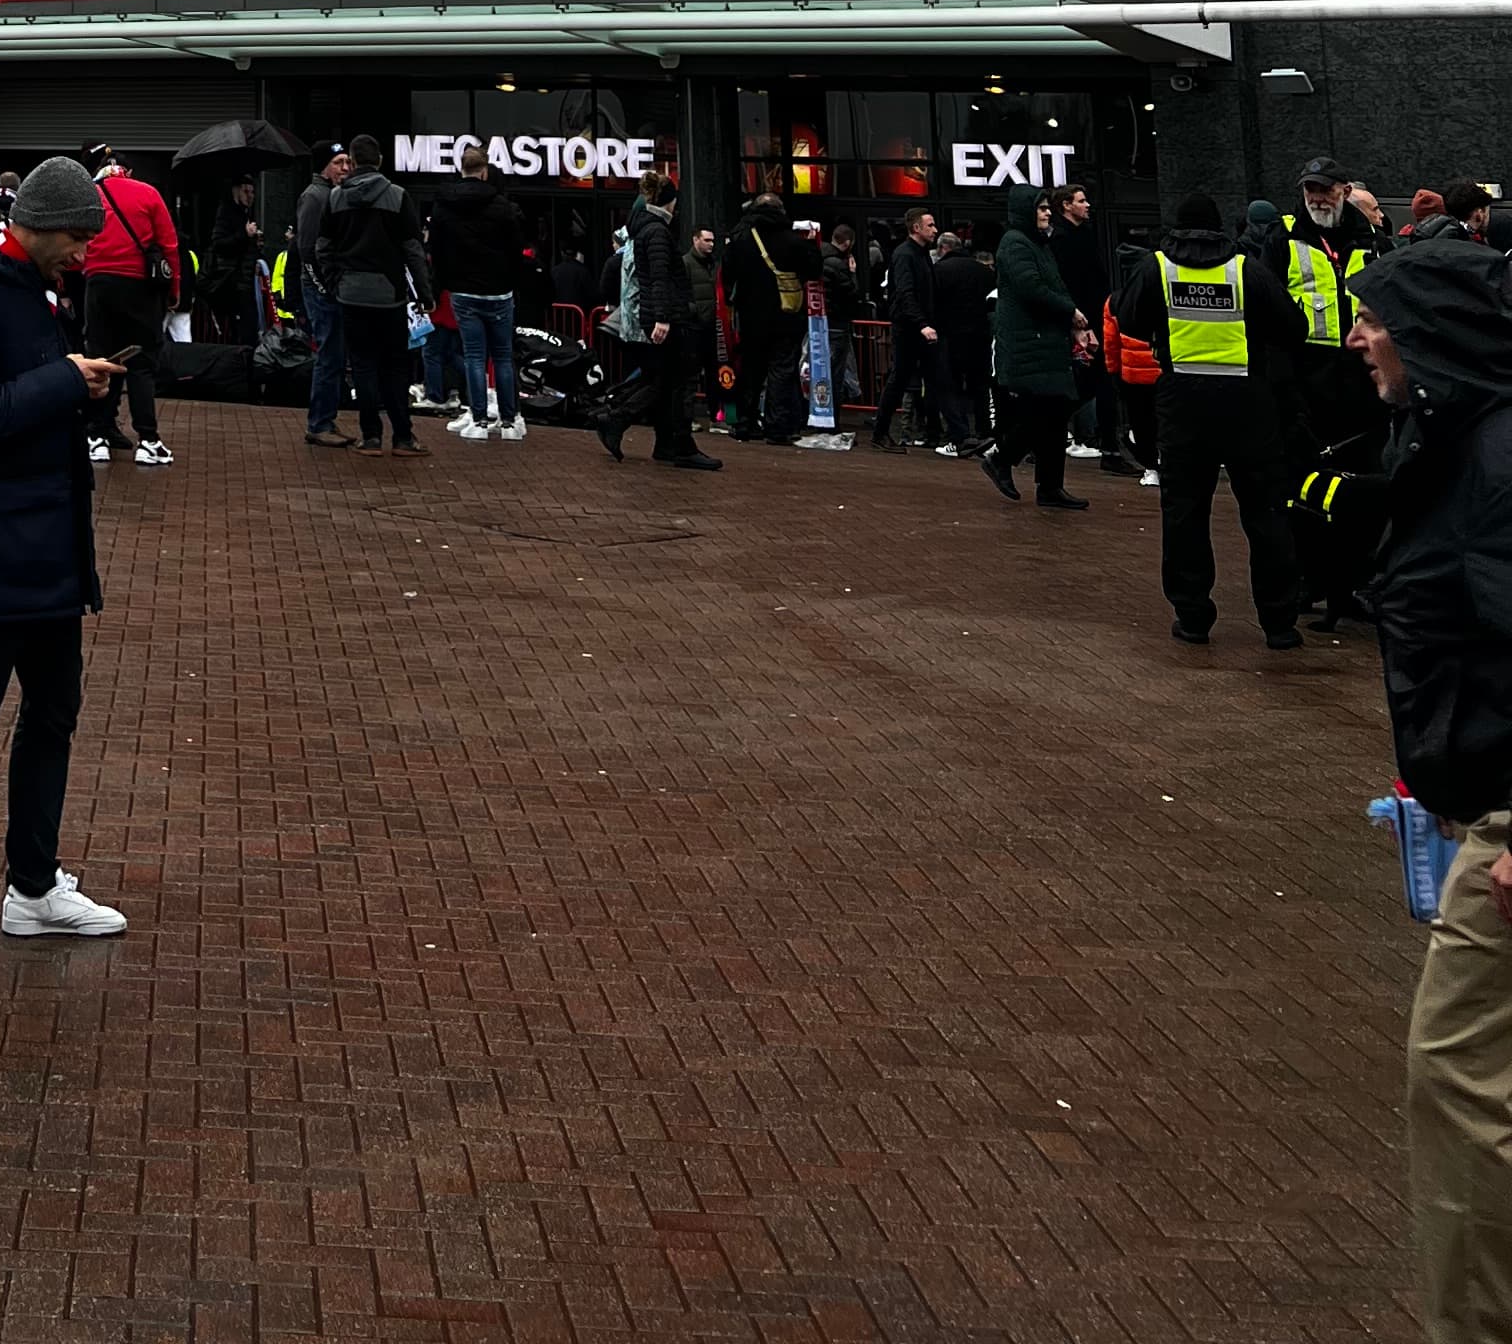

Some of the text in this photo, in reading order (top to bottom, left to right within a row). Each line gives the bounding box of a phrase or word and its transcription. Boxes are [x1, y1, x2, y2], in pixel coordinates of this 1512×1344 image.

[951, 142, 1076, 188] EXIT
[1187, 284, 1216, 296] DOG
[1173, 295, 1232, 308] HANDLER
